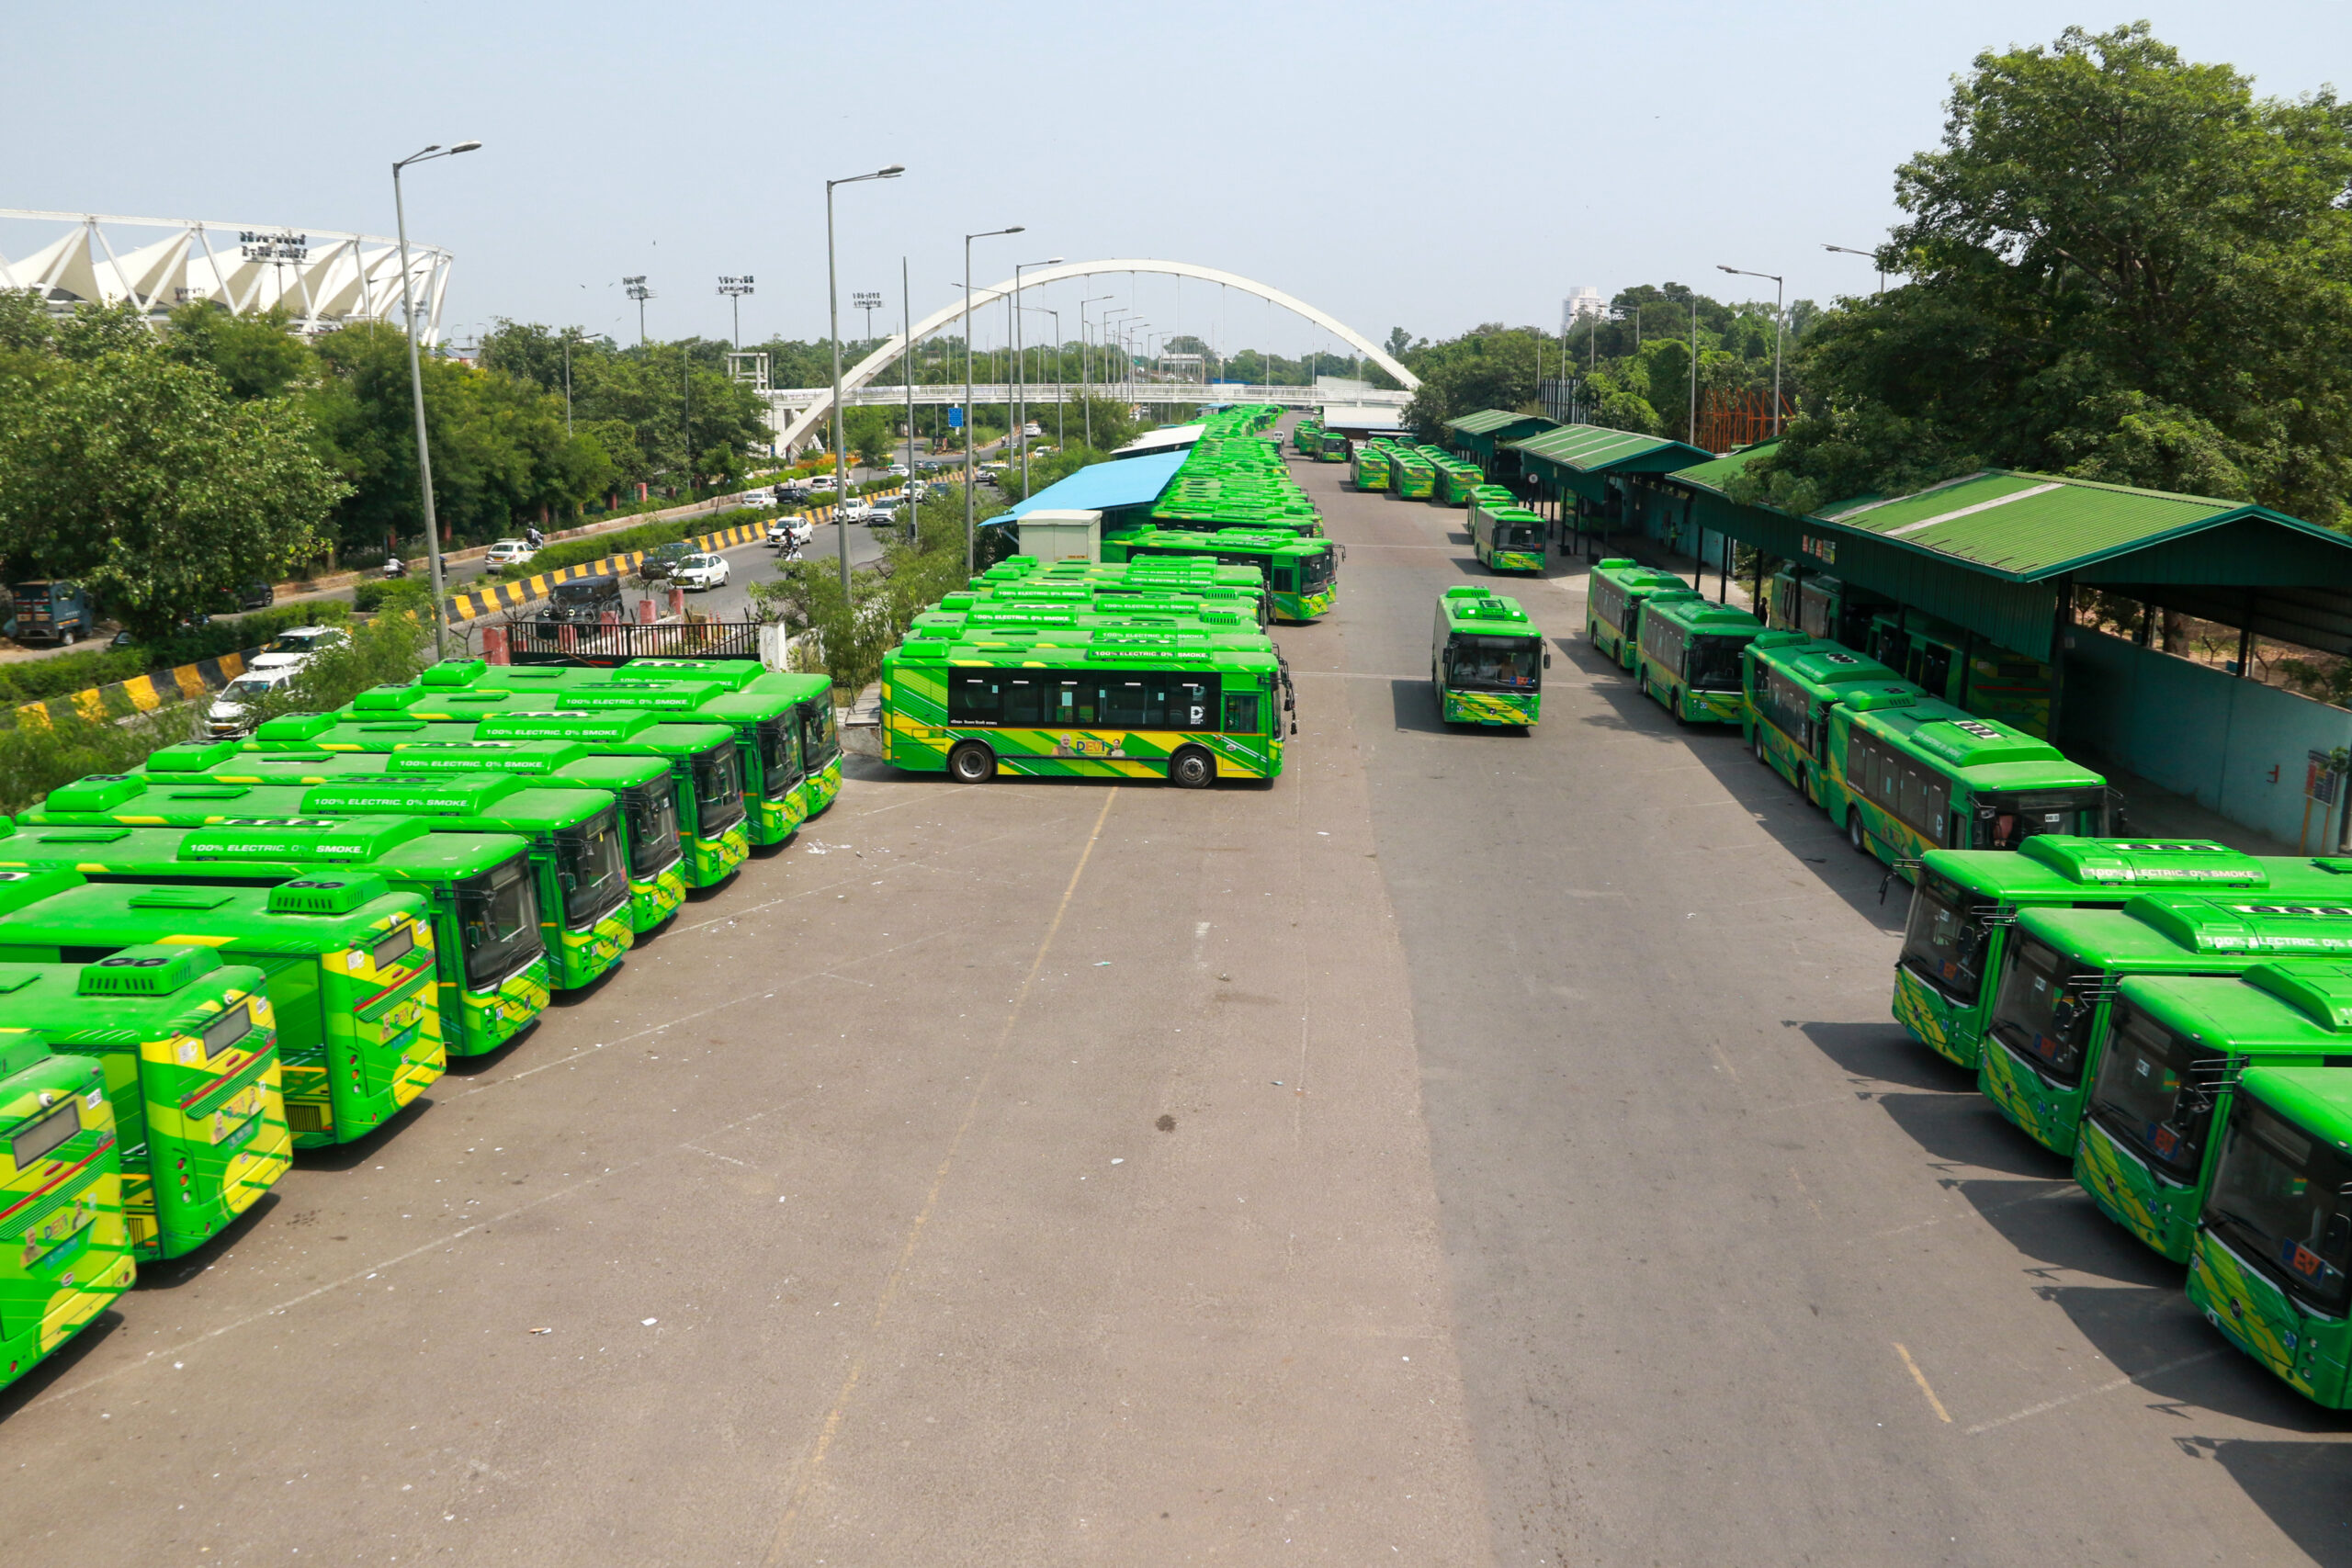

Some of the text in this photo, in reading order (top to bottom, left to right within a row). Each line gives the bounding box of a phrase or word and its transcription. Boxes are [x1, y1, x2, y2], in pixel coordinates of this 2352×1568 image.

[1076, 740, 1105, 752] DEVI
[227, 844, 286, 852] ELECTRIC.
[316, 845, 364, 853] SMOKE.
[2190, 870, 2208, 878] 0%
[2206, 936, 2245, 946] 100%
[2322, 938, 2346, 947] 0%
